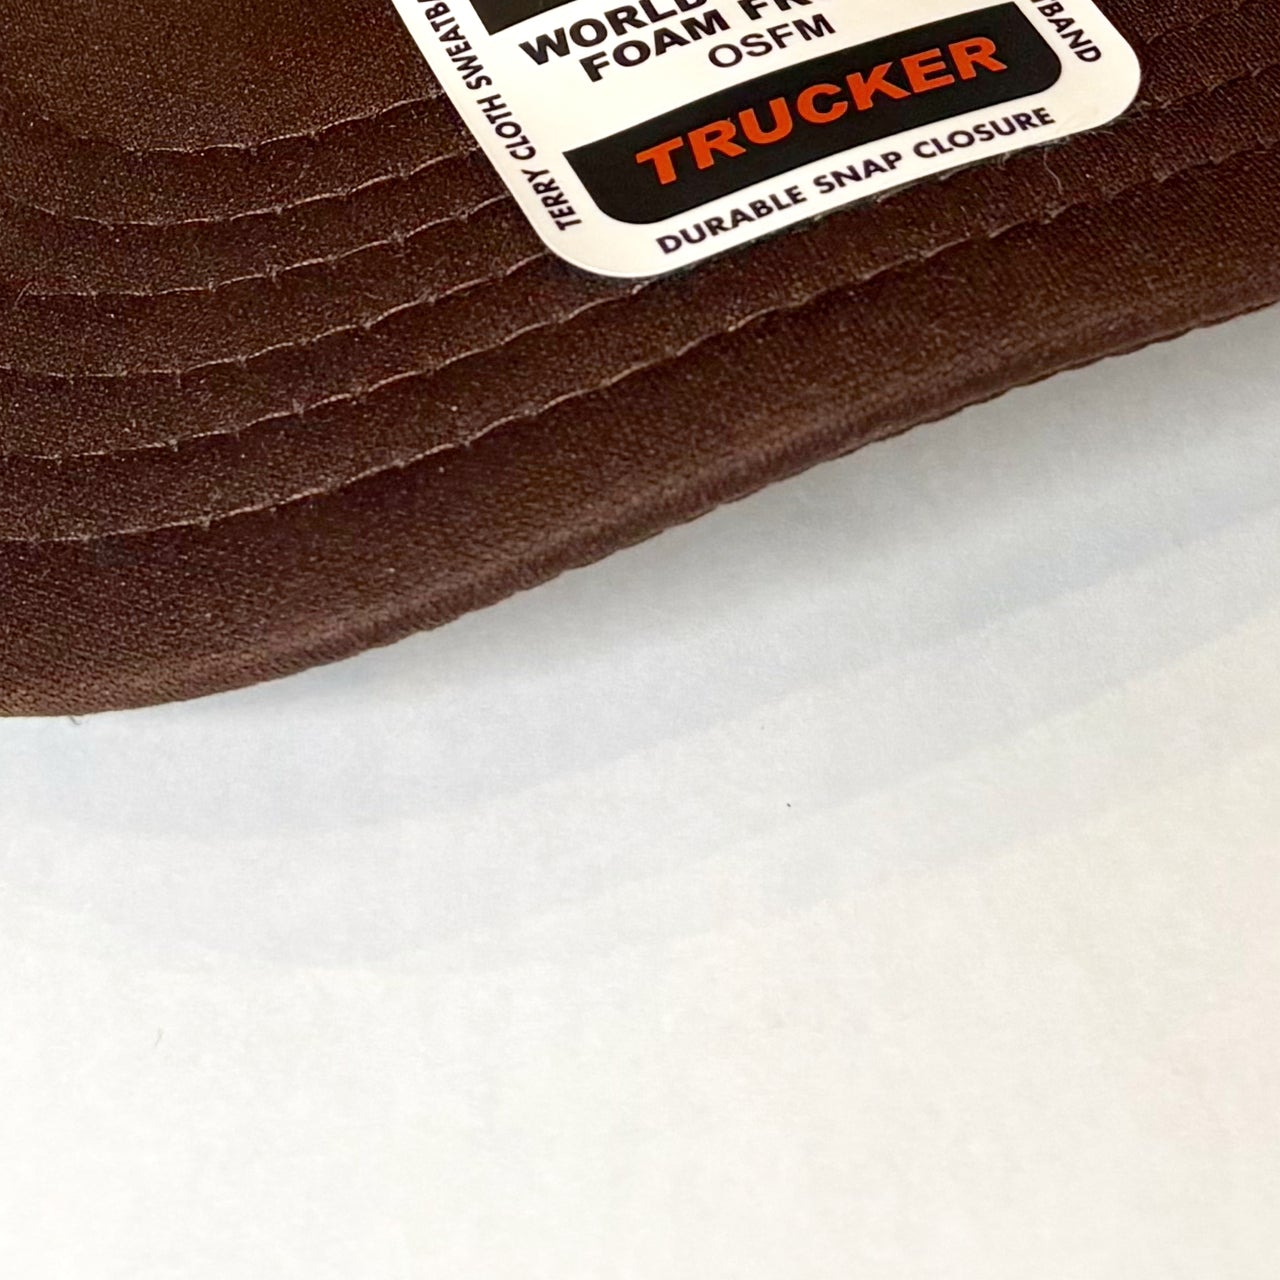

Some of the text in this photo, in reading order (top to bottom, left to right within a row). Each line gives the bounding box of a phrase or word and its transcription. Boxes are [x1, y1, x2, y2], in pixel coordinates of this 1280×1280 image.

[581, 9, 730, 83] FOAM
[708, 13, 837, 70] OSFM
[481, 91, 537, 161] CLOTH
[635, 35, 1007, 186] TRUCKER
[523, 167, 583, 232] TERRY
[656, 107, 1056, 256] DURABLE SNAP CLOSURE
